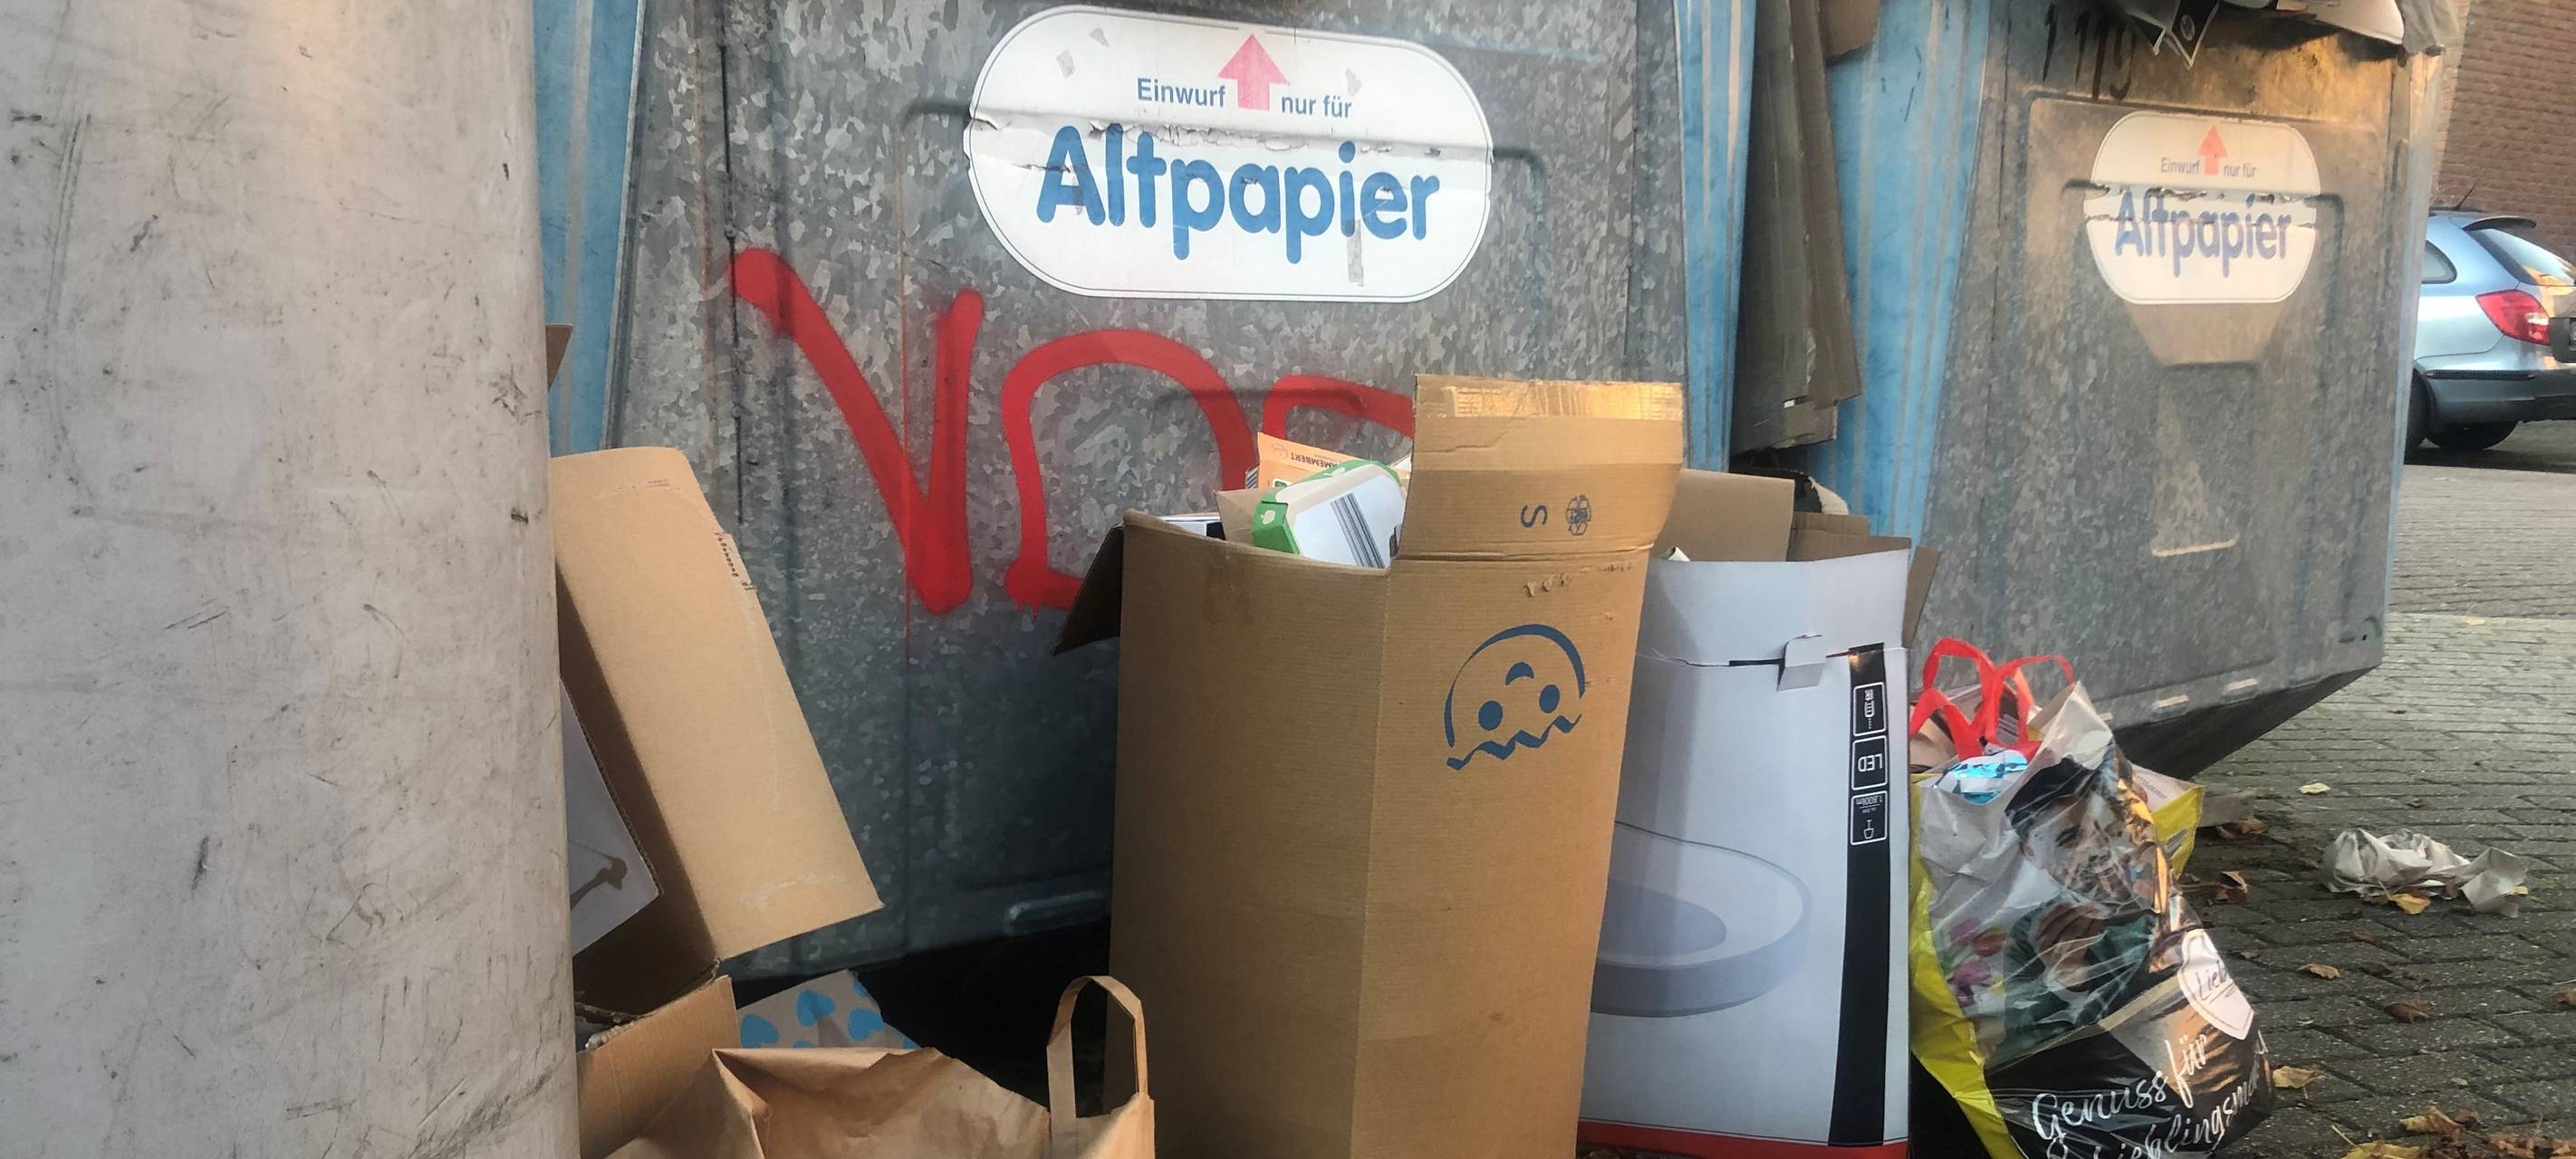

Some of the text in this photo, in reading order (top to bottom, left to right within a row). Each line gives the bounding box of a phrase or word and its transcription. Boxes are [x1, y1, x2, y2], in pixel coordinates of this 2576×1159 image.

[1137, 78, 1352, 119] Einwurf nur für
[1035, 121, 1440, 263] Altpapier
[2160, 158, 2257, 177] Einwurf nur für
[2114, 190, 2292, 278] Altpapier
[1858, 753, 1883, 771] LED
[2032, 1034, 2206, 1159] Genuss für
